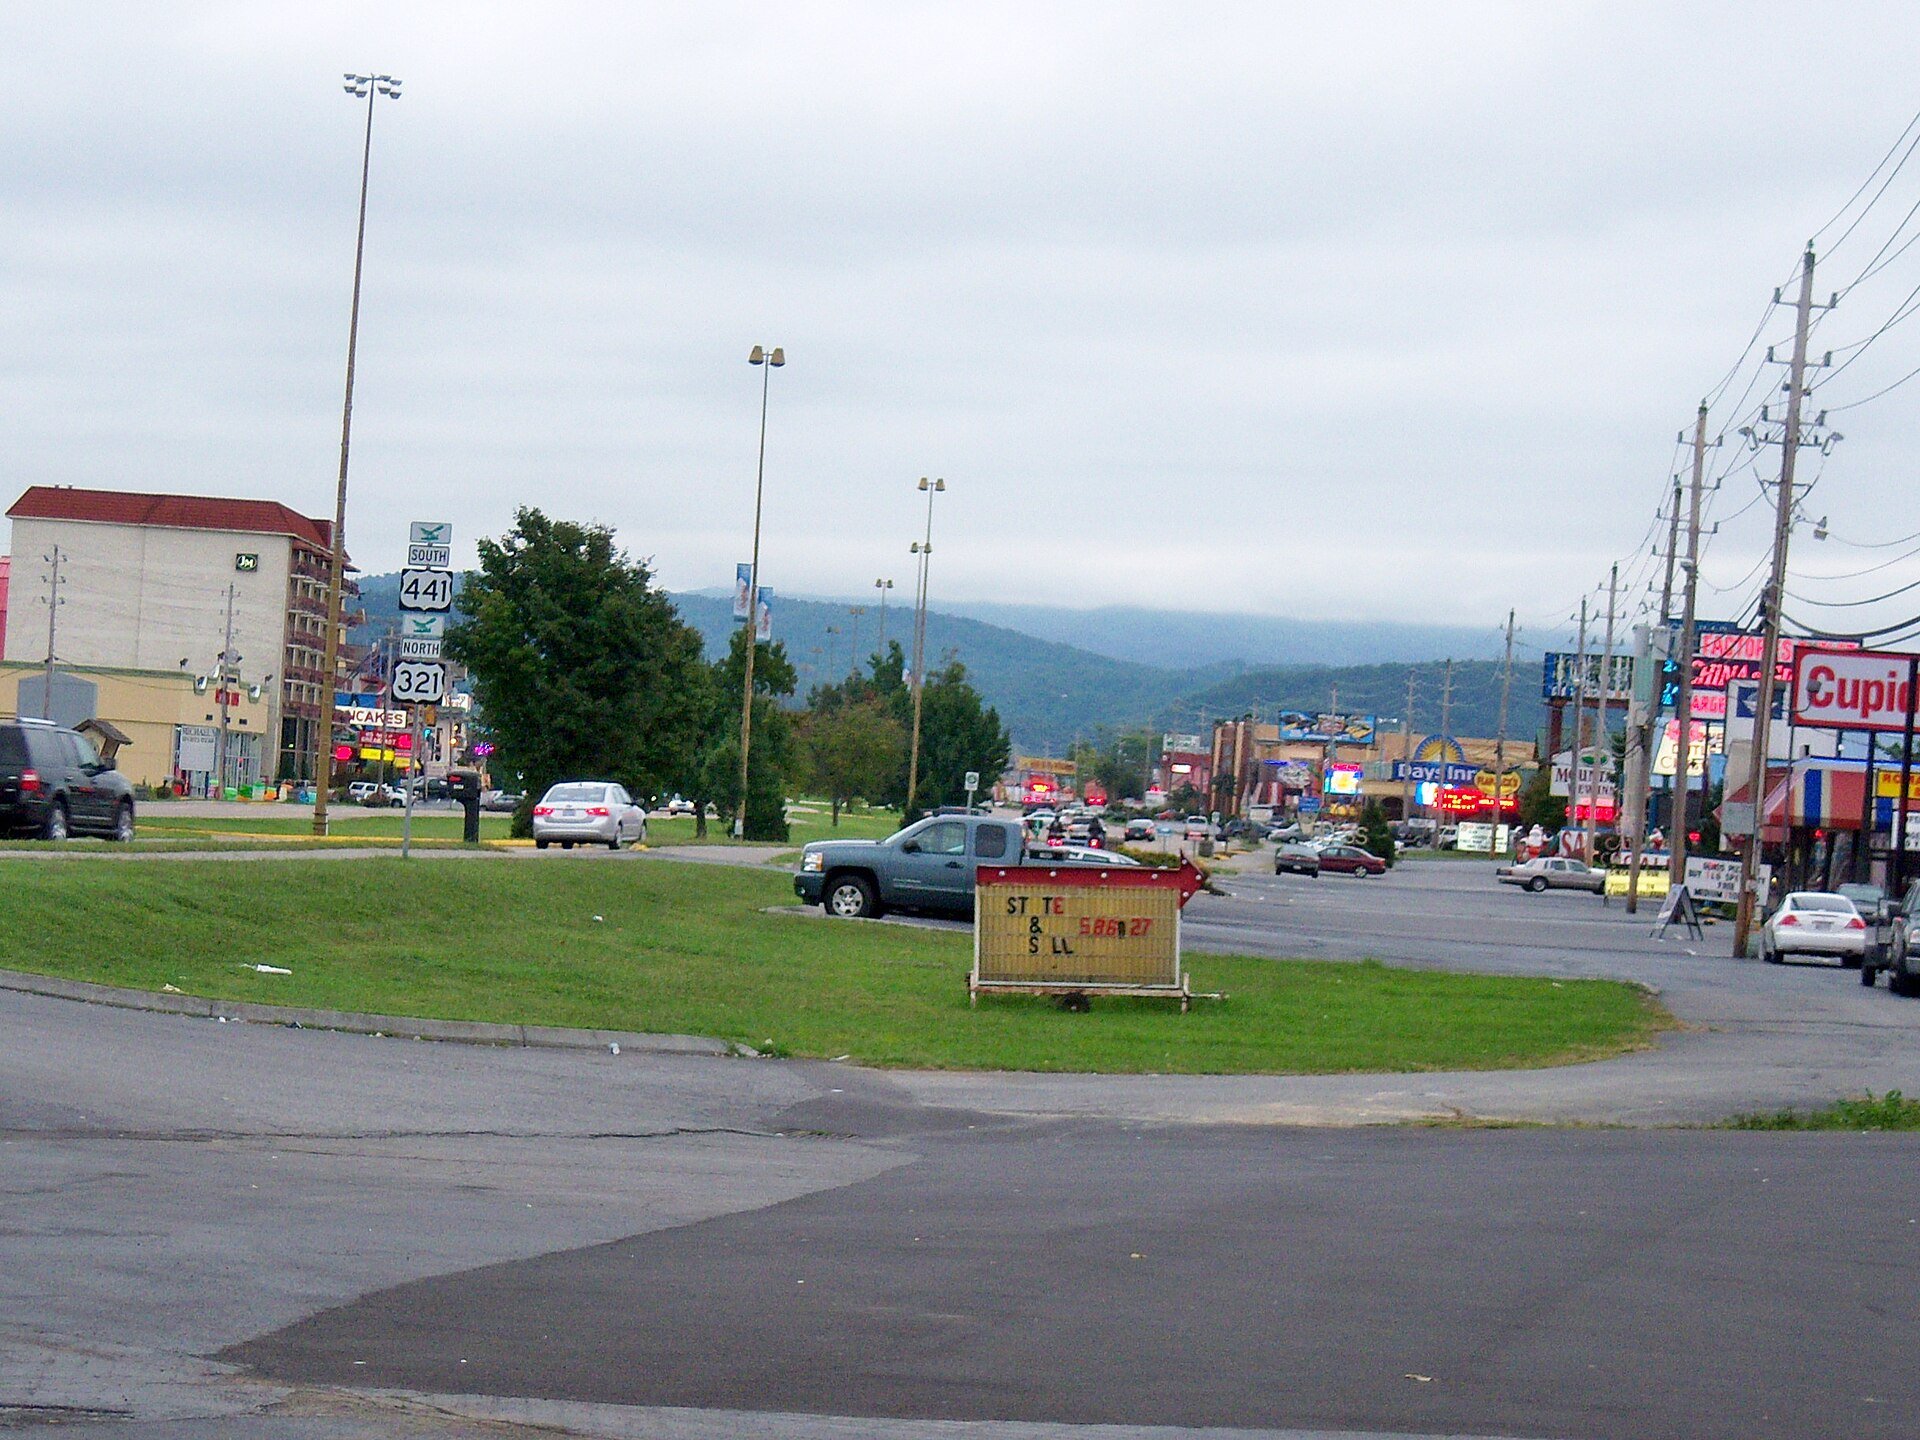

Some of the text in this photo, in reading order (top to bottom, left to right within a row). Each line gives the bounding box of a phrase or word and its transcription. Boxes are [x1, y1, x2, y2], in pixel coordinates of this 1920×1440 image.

[411, 550, 446, 562] SOUTH
[404, 578, 447, 602] 441
[403, 642, 439, 655] NORTH
[398, 670, 439, 694] 321
[1397, 763, 1442, 782] Days
[1030, 916, 1042, 934] &
